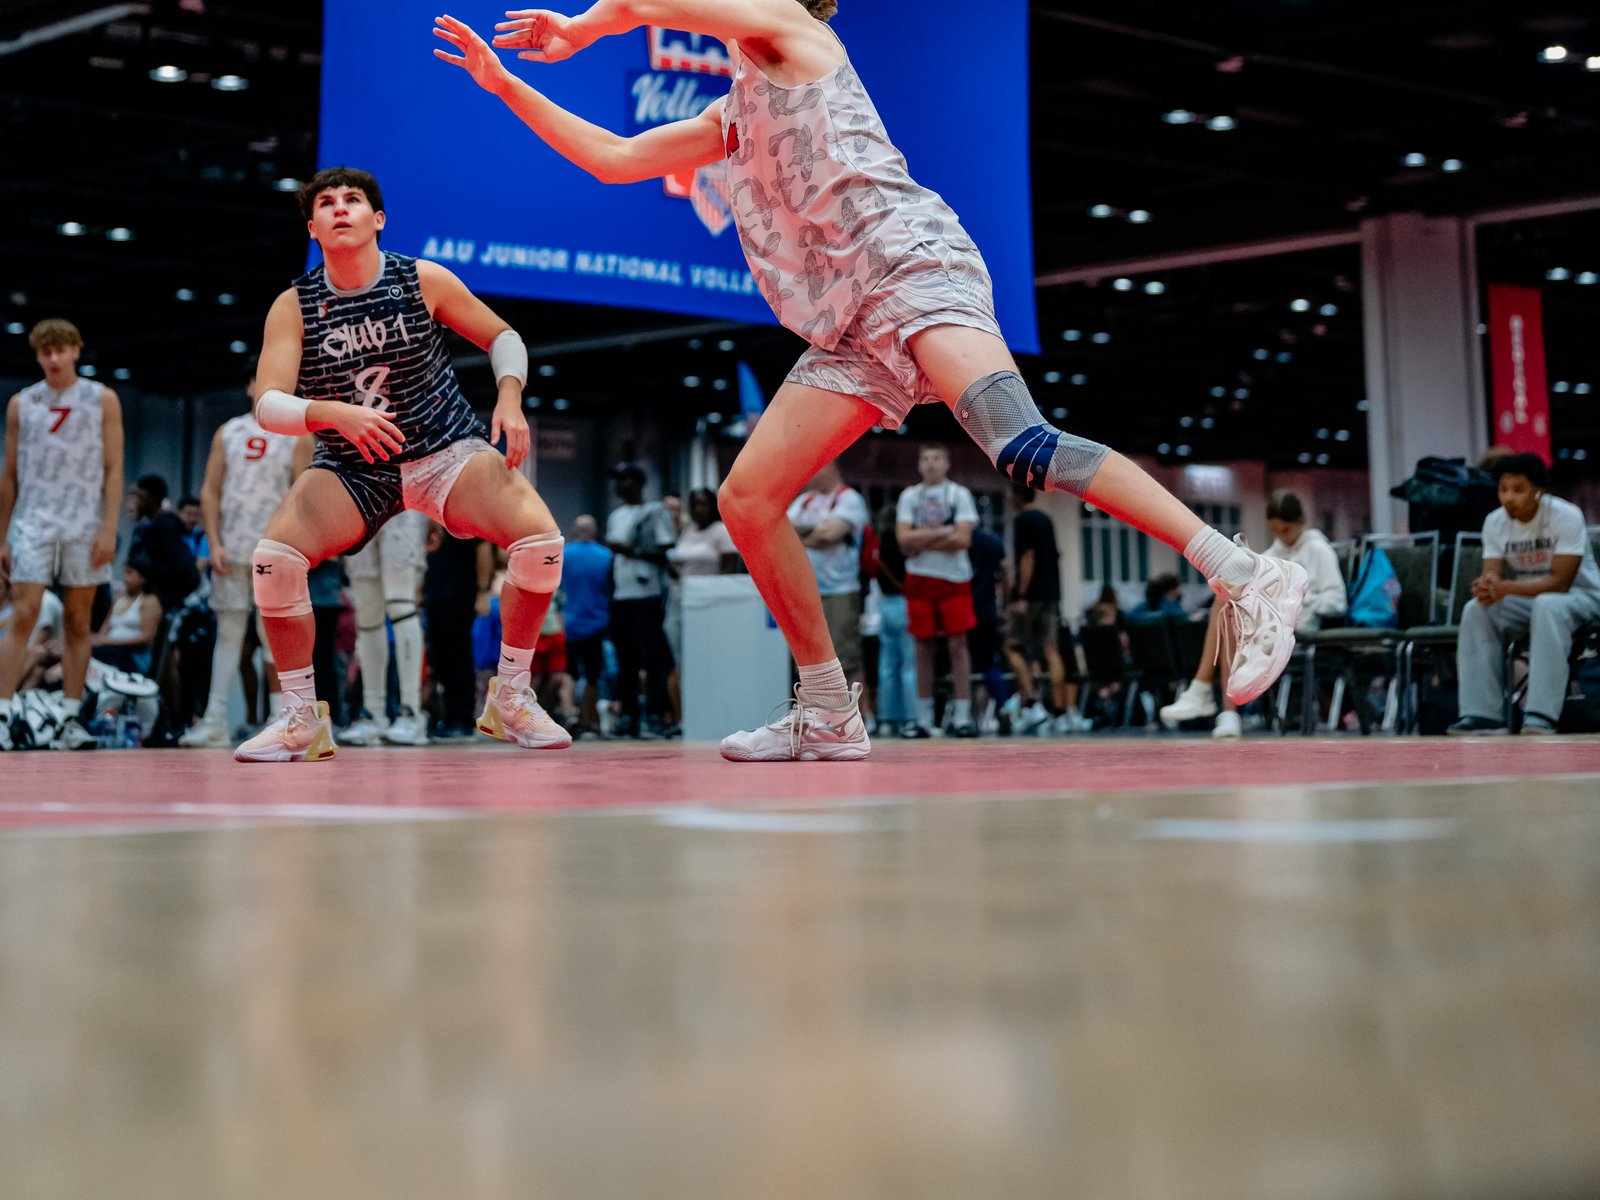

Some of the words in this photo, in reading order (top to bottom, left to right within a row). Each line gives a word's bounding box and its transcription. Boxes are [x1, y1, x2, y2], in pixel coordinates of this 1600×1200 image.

[423, 237, 474, 263] AAU
[480, 243, 568, 271] JUNIOR
[574, 253, 683, 285] NATIONAL
[690, 266, 760, 294] VOLLE
[393, 312, 411, 346] 1
[355, 366, 390, 411] 8
[49, 406, 71, 433] 7
[245, 436, 268, 461] 9
